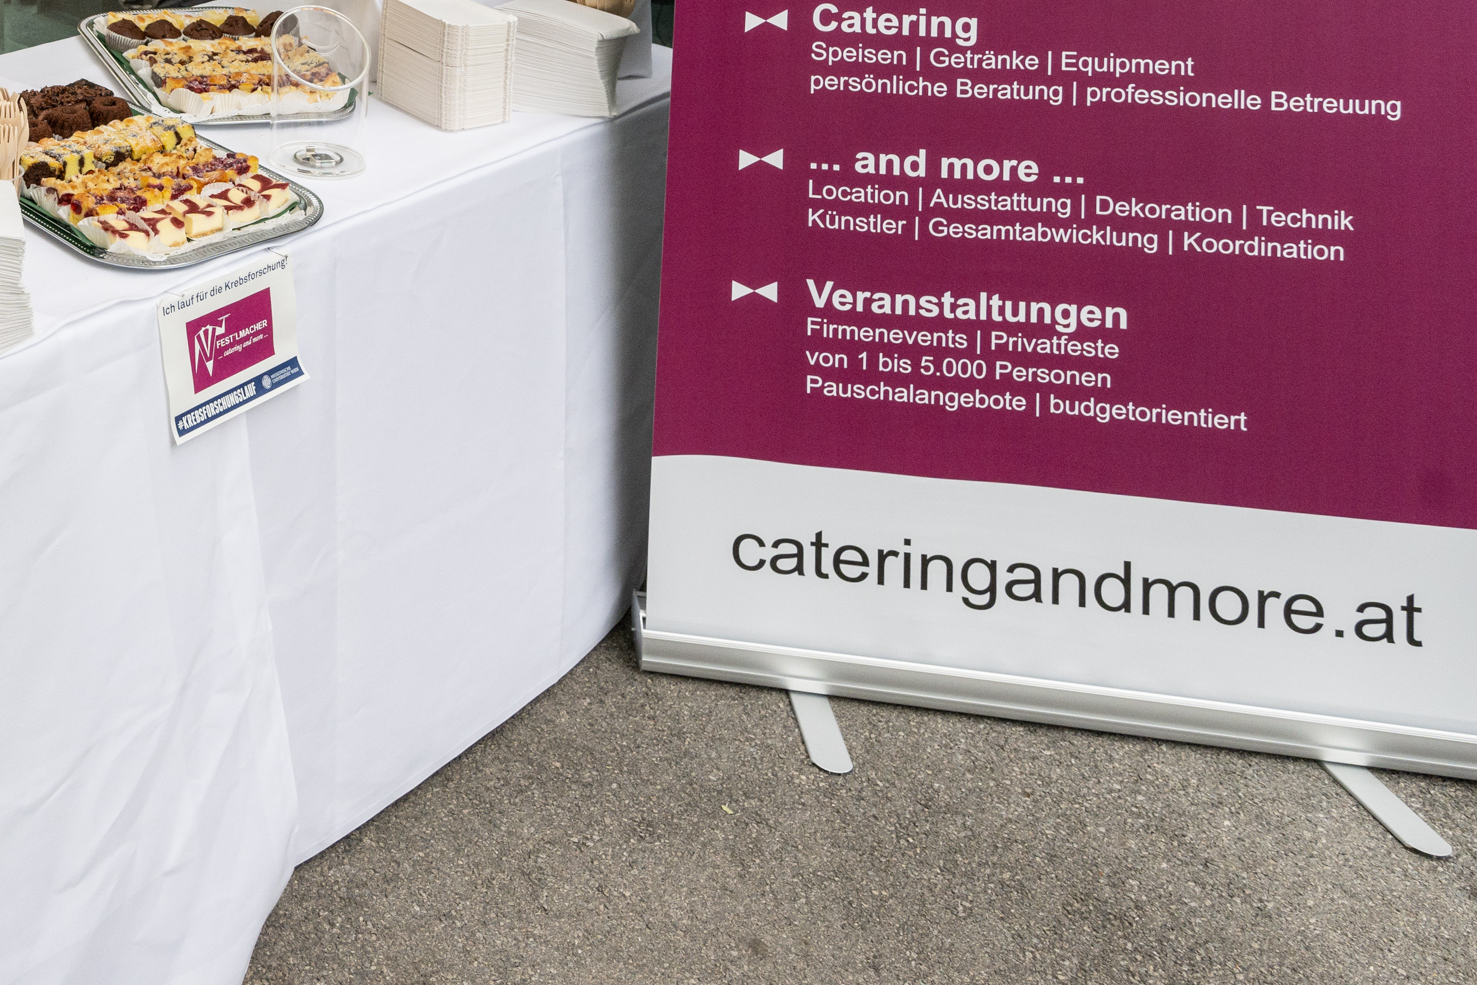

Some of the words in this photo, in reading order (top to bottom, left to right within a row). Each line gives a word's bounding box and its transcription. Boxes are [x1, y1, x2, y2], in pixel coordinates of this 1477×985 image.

[812, 2, 978, 47] Catering
[811, 41, 907, 66] Speisen
[929, 47, 1039, 71] Getränke
[1061, 51, 1195, 78] Equipment
[810, 73, 948, 98] persönliche
[956, 78, 1063, 106] Beratung
[1086, 83, 1262, 111] professionelle
[1270, 90, 1402, 121] Betreuung
[810, 162, 840, 171] ...
[854, 148, 927, 178] and
[940, 157, 1039, 183] more
[1053, 175, 1084, 184] ...
[808, 179, 909, 206] Location
[929, 188, 1071, 219] Ausstattung
[1095, 195, 1232, 224] Dekoration
[1255, 205, 1355, 231] Technik
[808, 208, 907, 235] Künstler
[928, 217, 1158, 254] Gesamtabwicklung
[1183, 231, 1344, 262] Koordination
[162, 303, 176, 317] Ich
[177, 296, 195, 311] lauf
[196, 290, 209, 303] für
[209, 284, 223, 297] die
[224, 256, 288, 291] Krebsforschung!
[806, 278, 1128, 334] Veranstaltungen
[807, 317, 968, 349] Firmenevents
[991, 331, 1120, 359] Privatfeste
[805, 350, 848, 369] von
[858, 351, 867, 371] 1
[878, 352, 912, 374] bis
[920, 356, 987, 379] 5.000
[995, 360, 1111, 389] Personen
[177, 382, 257, 431] #KREBSFORSCHUNGSLAUF
[806, 374, 1027, 412] Pauschalangebote
[1049, 393, 1248, 432] budgetorientiert
[732, 530, 1423, 648] cateringandmore.at
